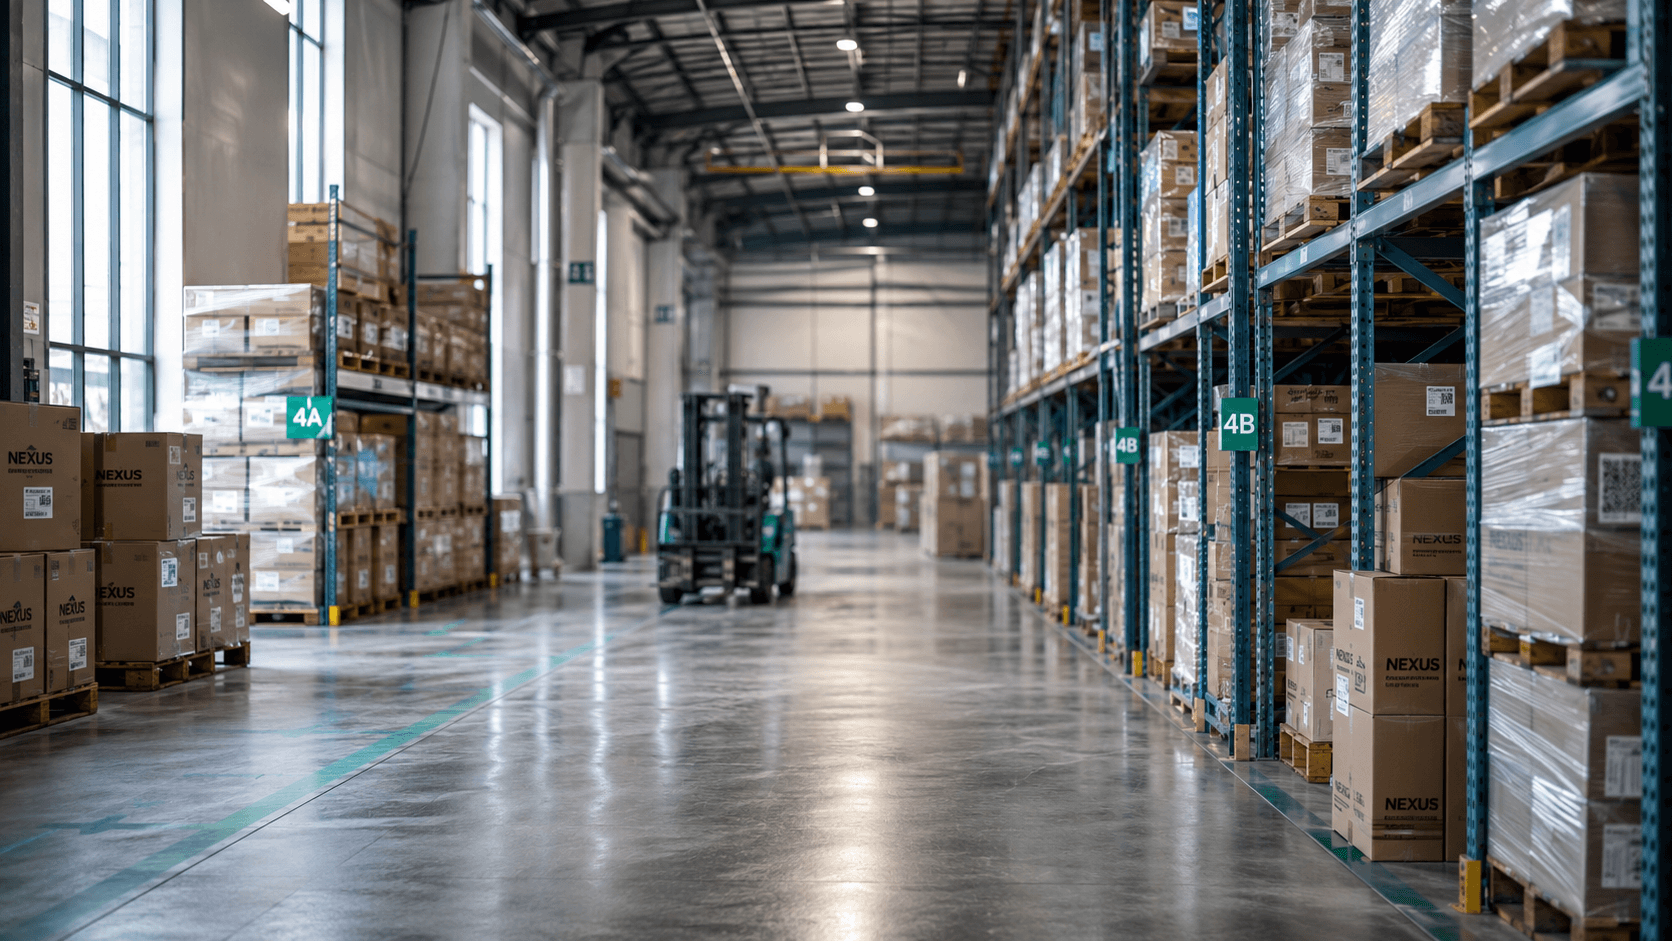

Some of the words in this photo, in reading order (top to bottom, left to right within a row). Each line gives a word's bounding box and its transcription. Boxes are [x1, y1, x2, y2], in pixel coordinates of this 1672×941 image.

[293, 407, 323, 427] 4A
[1223, 413, 1255, 434] 4B
[1116, 437, 1138, 453] 4B
[8, 451, 53, 465] NEXUS
[95, 469, 142, 480] NEXUS
[1412, 534, 1462, 544] NEXUS
[95, 587, 135, 599] EXUS
[59, 601, 85, 616] NEXUS
[0, 608, 32, 624] NEXUS
[1386, 657, 1440, 671] NEXUS
[1385, 797, 1439, 811] NEXUS
